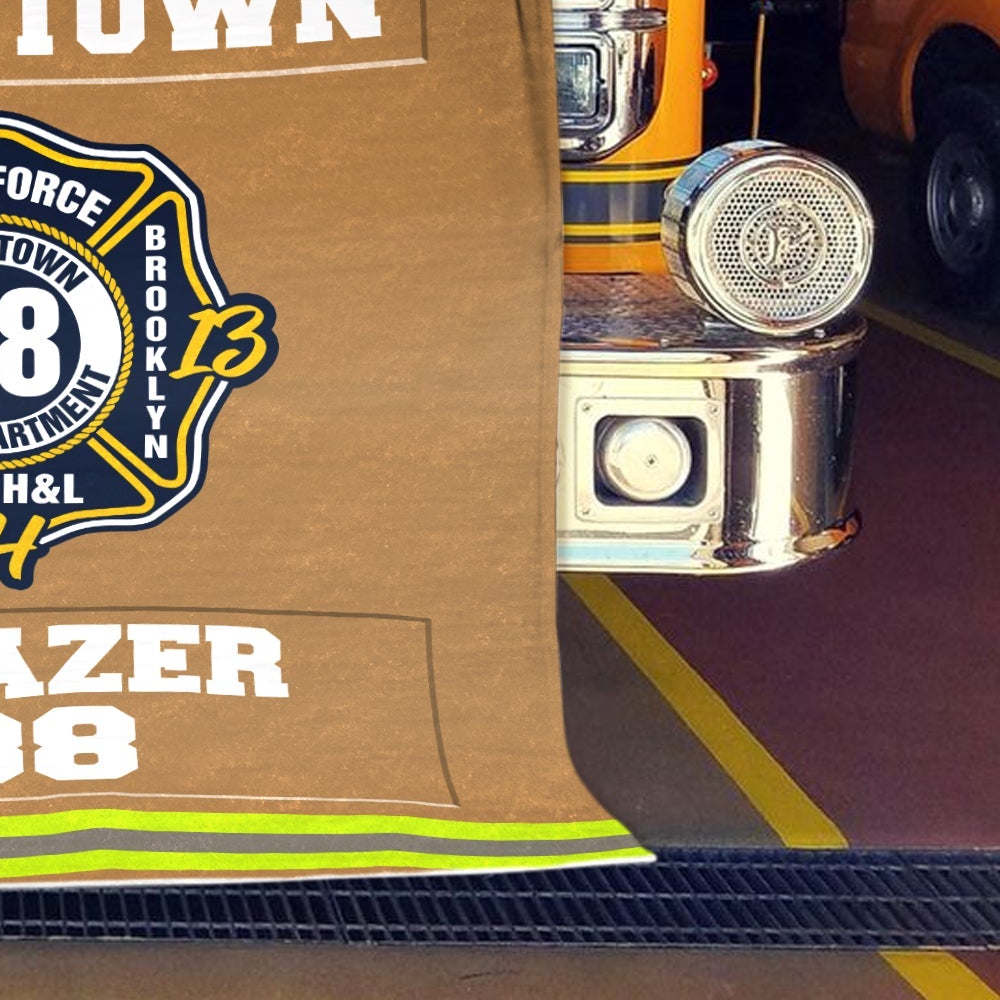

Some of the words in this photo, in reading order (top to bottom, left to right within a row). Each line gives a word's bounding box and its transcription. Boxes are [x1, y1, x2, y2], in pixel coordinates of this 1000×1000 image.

[143, 224, 168, 459] BROOKLYN
[168, 304, 268, 380] 13
[2, 472, 85, 505] H&L
